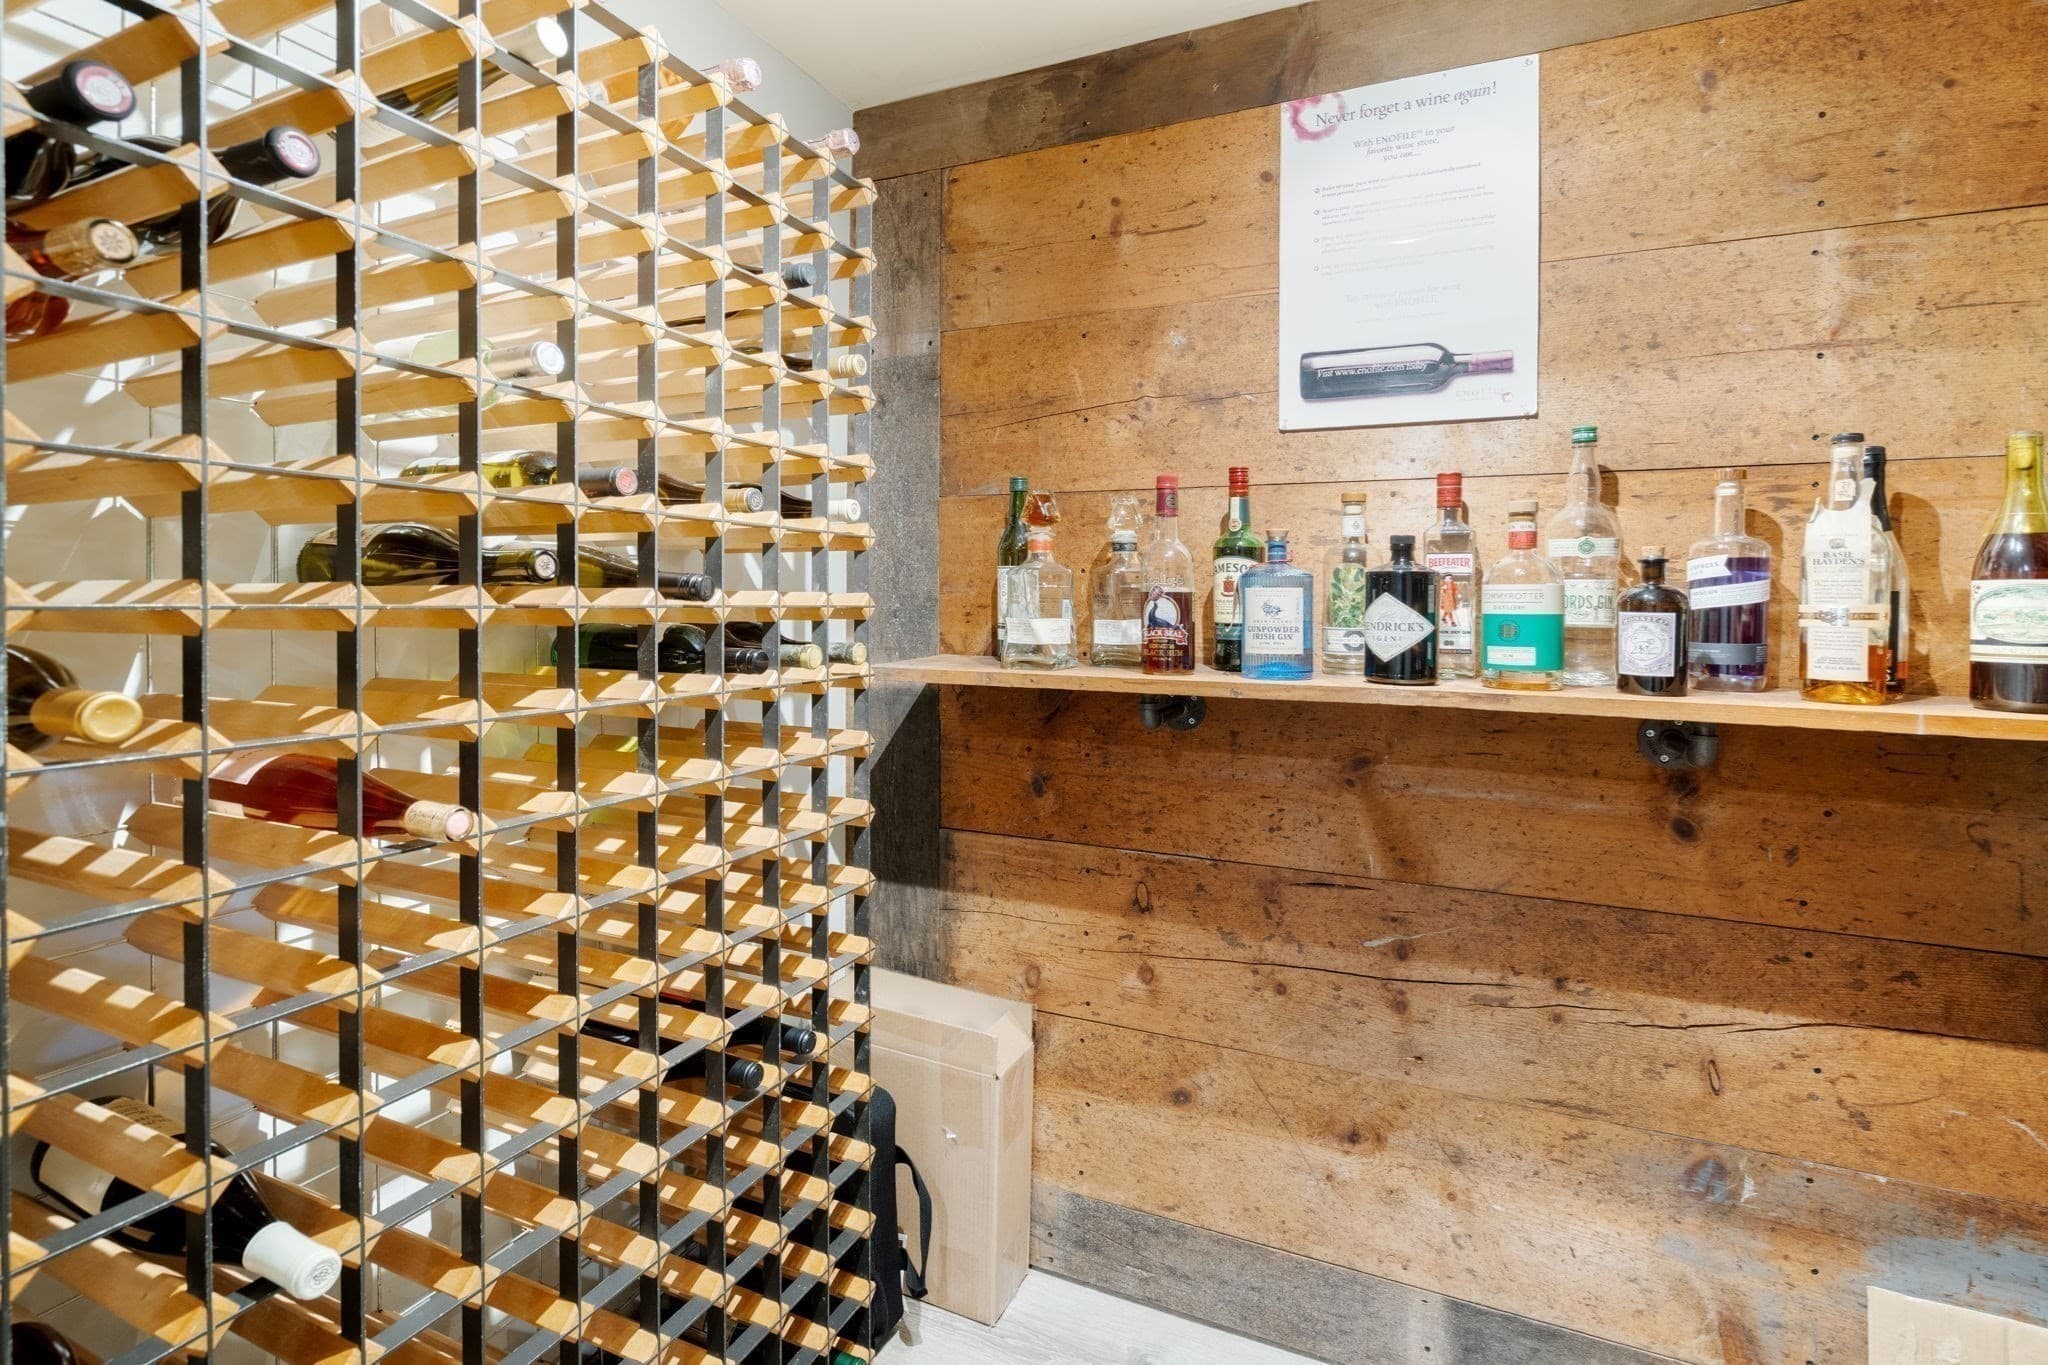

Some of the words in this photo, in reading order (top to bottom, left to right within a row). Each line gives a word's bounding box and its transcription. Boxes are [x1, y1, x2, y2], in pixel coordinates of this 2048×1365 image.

[1315, 111, 1356, 127] Never
[1360, 103, 1400, 120] forget
[1404, 101, 1412, 111] a
[1416, 92, 1450, 108] wine
[1454, 80, 1497, 105] again!
[1354, 138, 1373, 149] With
[1436, 125, 1456, 136] your
[1395, 142, 1415, 150] wine
[1383, 154, 1398, 162] you
[1428, 556, 1471, 568] BEEFEATER
[1564, 594, 1593, 609] ORDS
[1597, 594, 1613, 609] GIN
[1248, 625, 1300, 633] GUNPOWDER
[1366, 621, 1425, 632] ENDRICK'S
